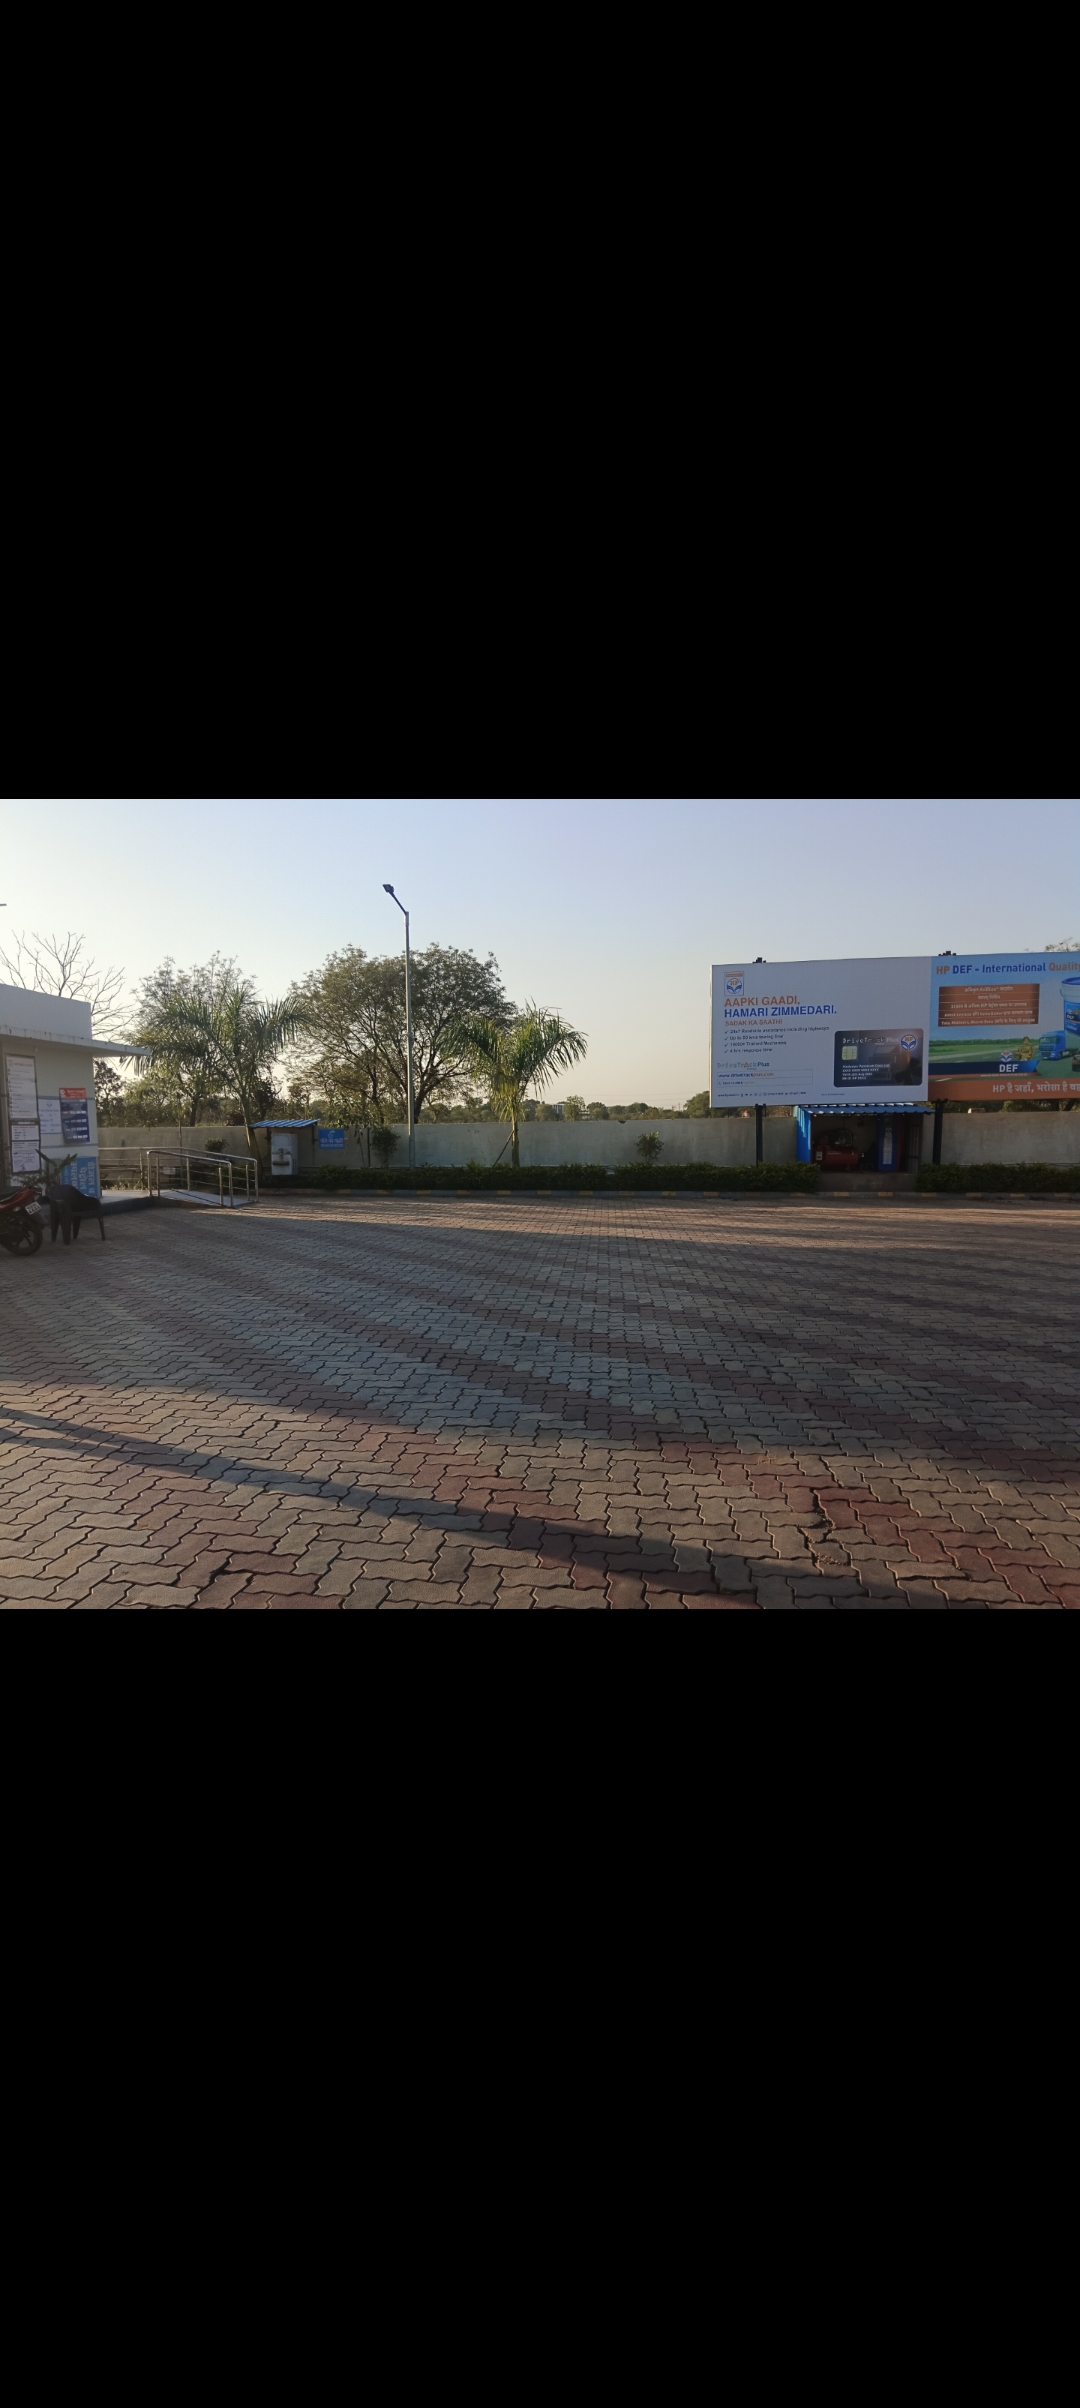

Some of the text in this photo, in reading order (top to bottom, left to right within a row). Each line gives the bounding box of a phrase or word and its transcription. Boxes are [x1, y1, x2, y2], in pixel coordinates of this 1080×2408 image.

[936, 966, 950, 974] HP
[952, 965, 972, 974] DEF
[982, 963, 1046, 973] International
[724, 995, 800, 1007] AAPKI GAADI,
[724, 1005, 837, 1018] HAMARI ZIMMEDARI.
[999, 1064, 1018, 1072] DEF
[992, 1084, 1005, 1093] HP
[1007, 1082, 1013, 1093] है
[1014, 1081, 1034, 1093] जहाँ,
[1037, 1081, 1060, 1092] भरोसा
[1062, 1081, 1068, 1092] है
